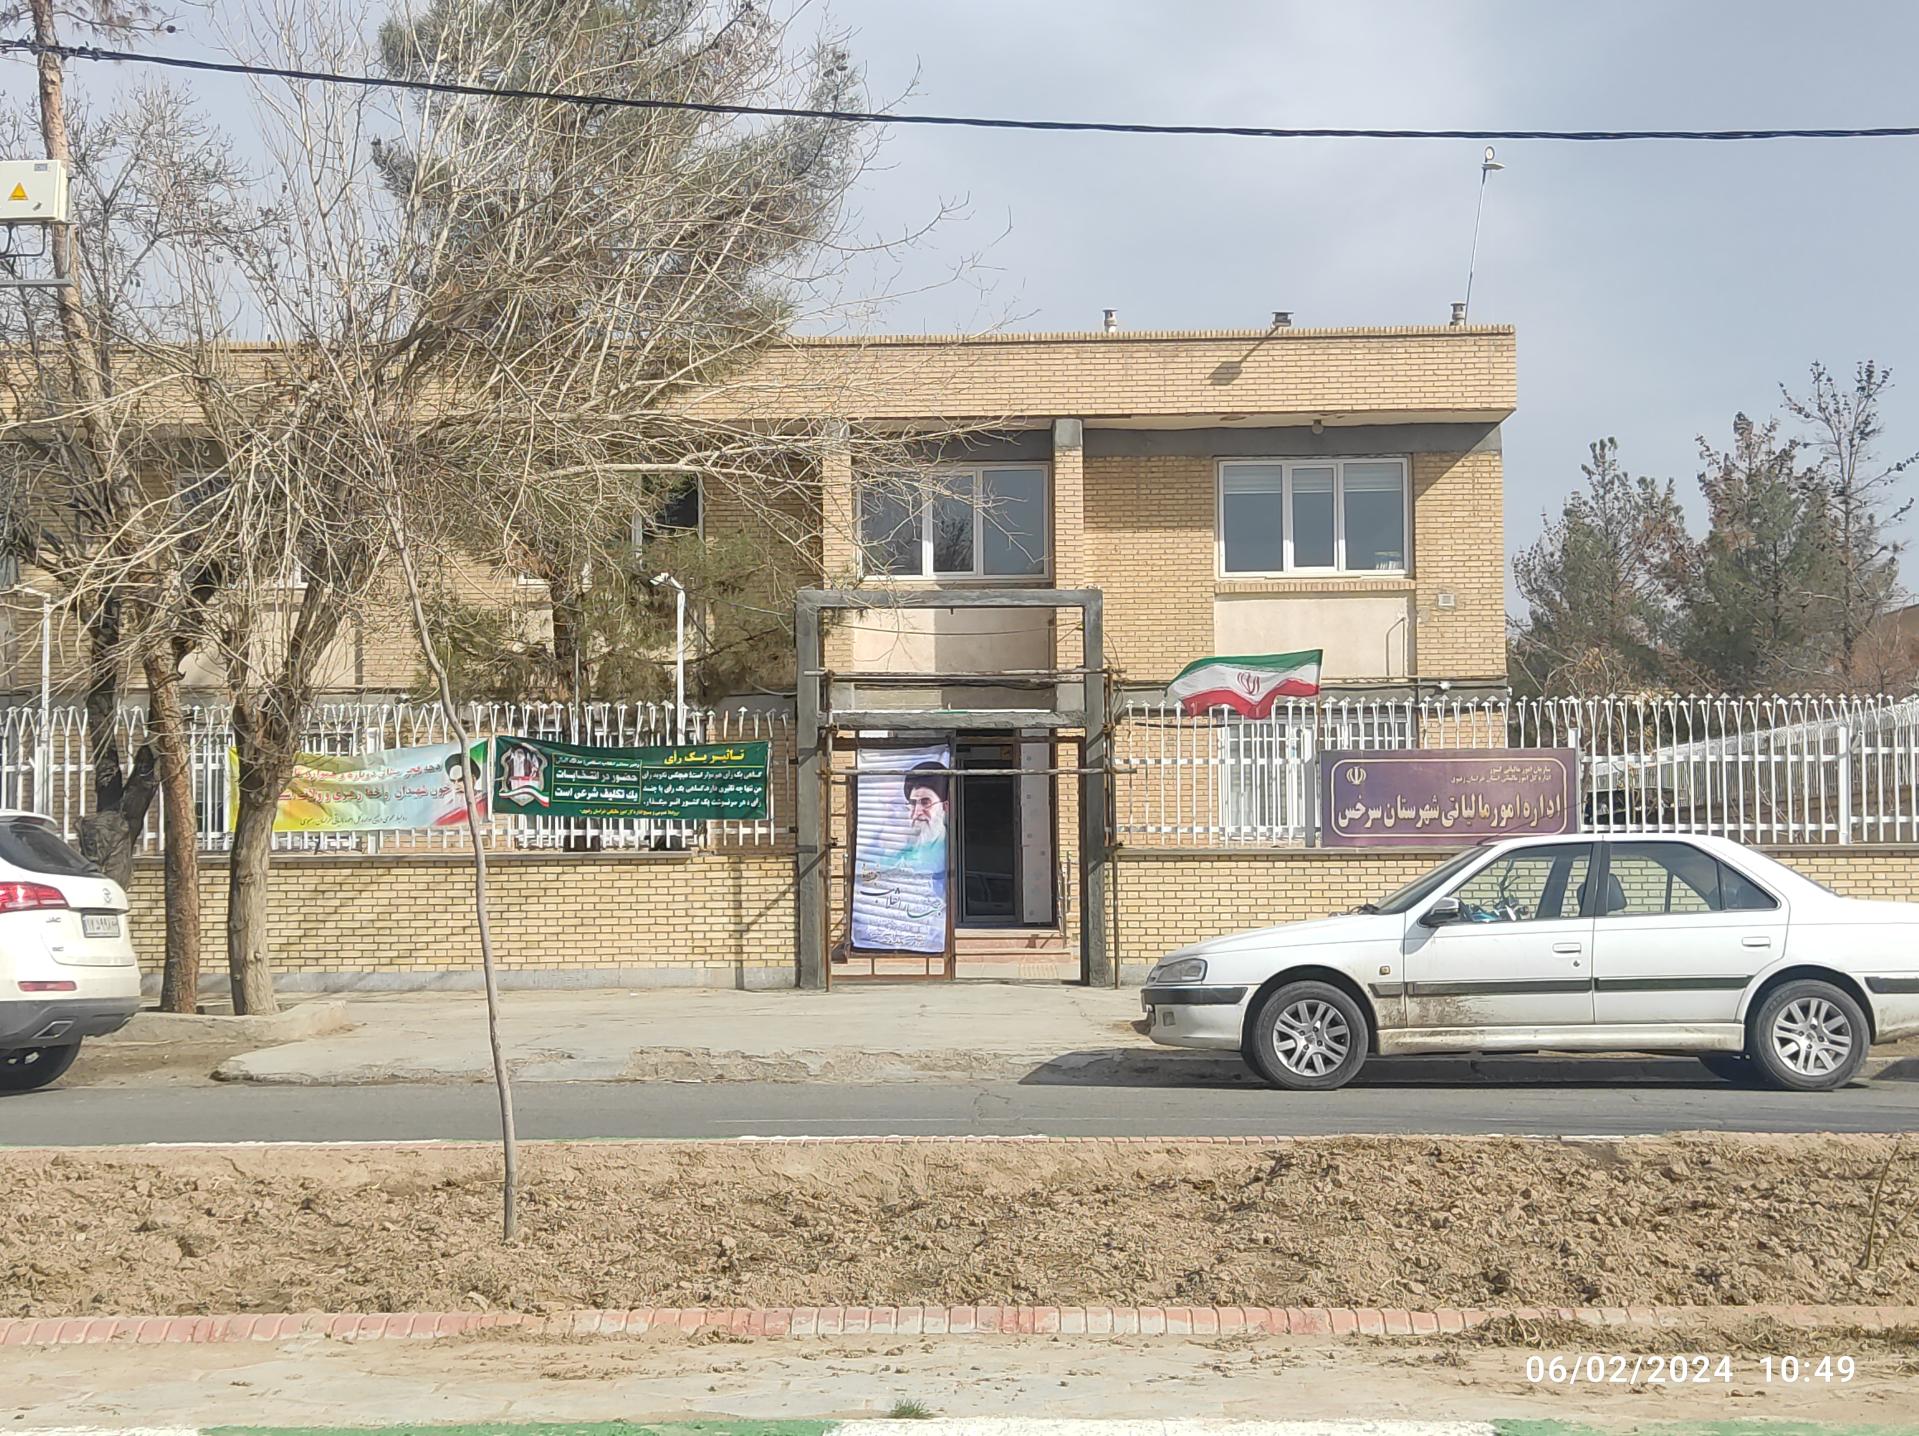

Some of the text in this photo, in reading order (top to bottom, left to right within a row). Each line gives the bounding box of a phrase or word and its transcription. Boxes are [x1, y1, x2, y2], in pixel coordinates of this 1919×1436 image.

[684, 751, 707, 764] یک
[601, 774, 610, 782] در
[612, 773, 638, 784] حضور
[554, 787, 573, 797] است
[574, 786, 599, 800] شرعی
[600, 788, 625, 801] تکلیف
[1338, 792, 1561, 828] اداره امور مالیاتی شهرستان سرخس
